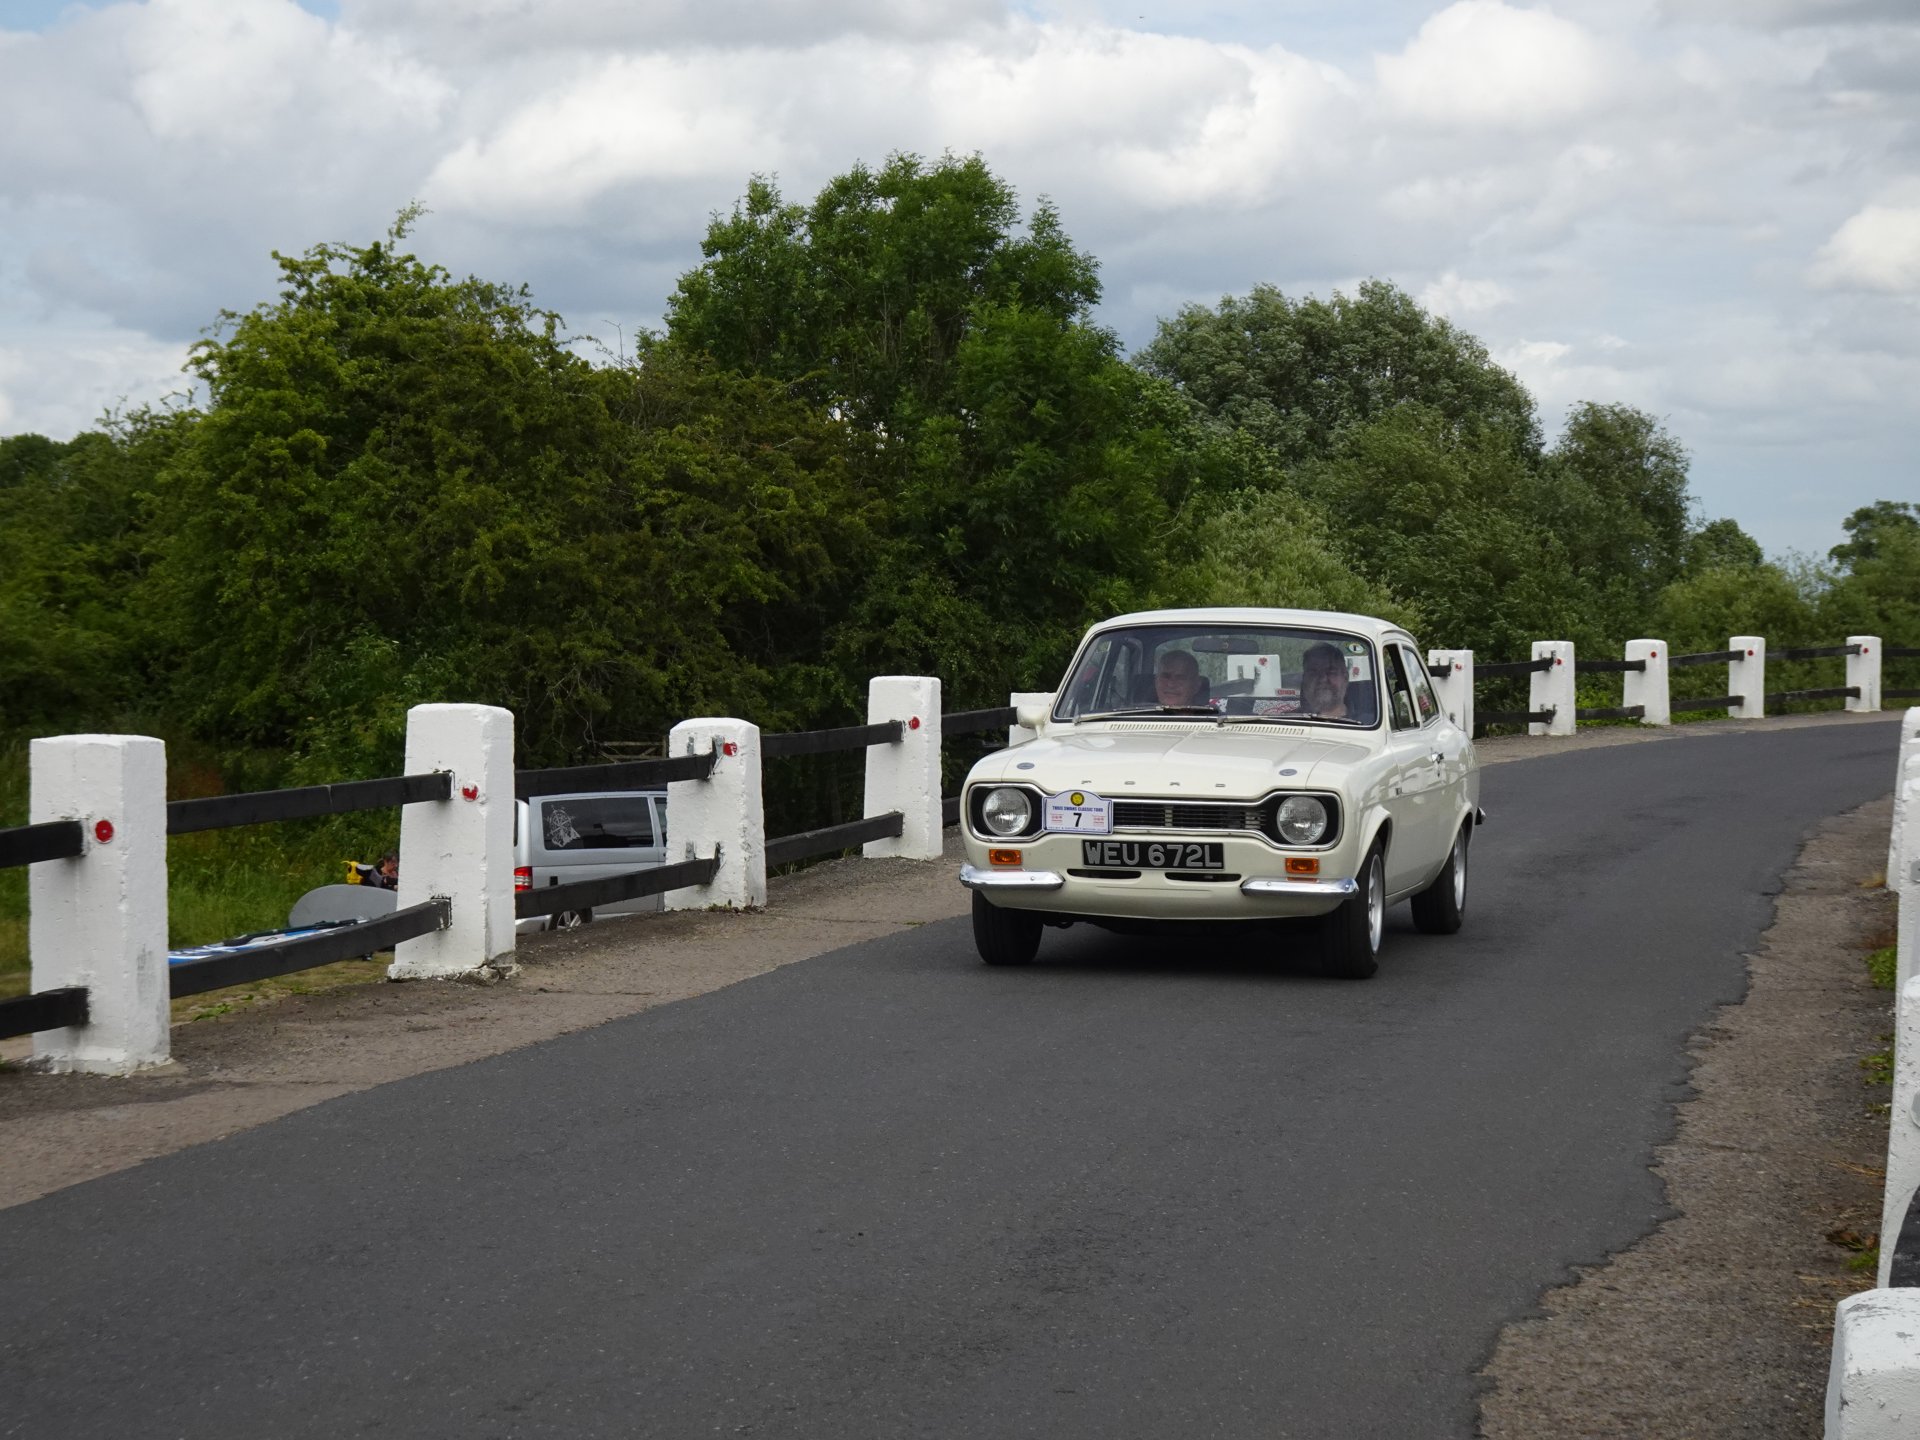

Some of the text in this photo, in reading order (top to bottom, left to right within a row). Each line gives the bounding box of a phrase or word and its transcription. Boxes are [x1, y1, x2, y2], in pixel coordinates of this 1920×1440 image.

[1073, 812, 1082, 827] 7
[1085, 842, 1222, 867] WEU 672L
